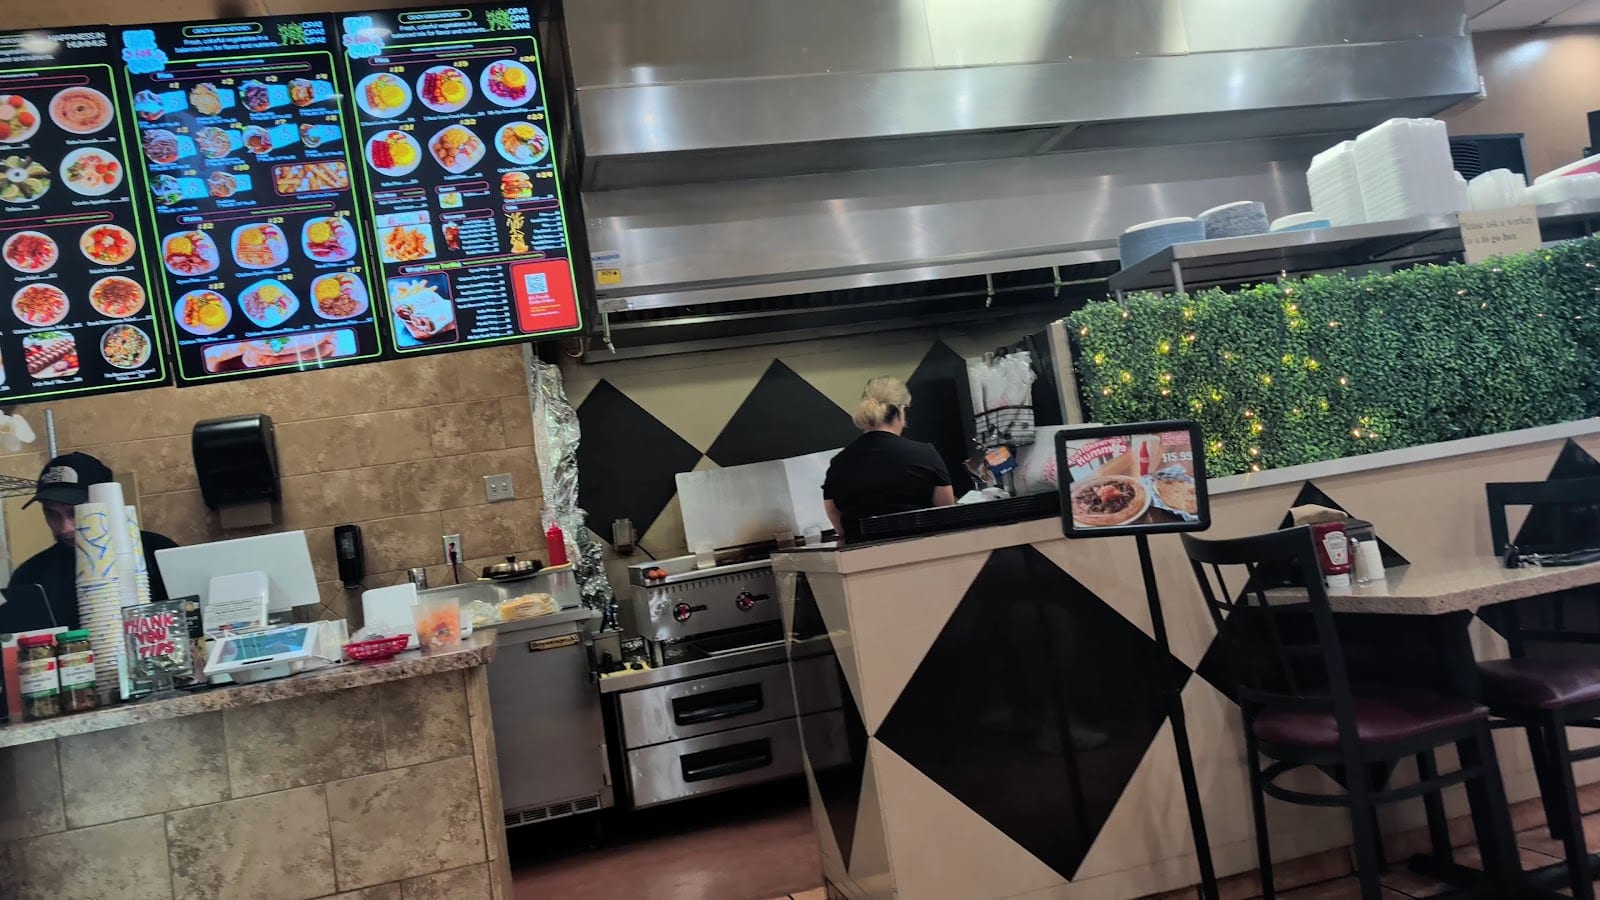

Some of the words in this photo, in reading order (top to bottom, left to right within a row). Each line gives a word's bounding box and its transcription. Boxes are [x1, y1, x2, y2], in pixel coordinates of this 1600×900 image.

[1503, 232, 1517, 241] box
[1162, 451, 1193, 463] $15.99
[123, 612, 175, 635] THANK
[134, 627, 167, 645] YOU
[139, 640, 175, 658] TIPS
